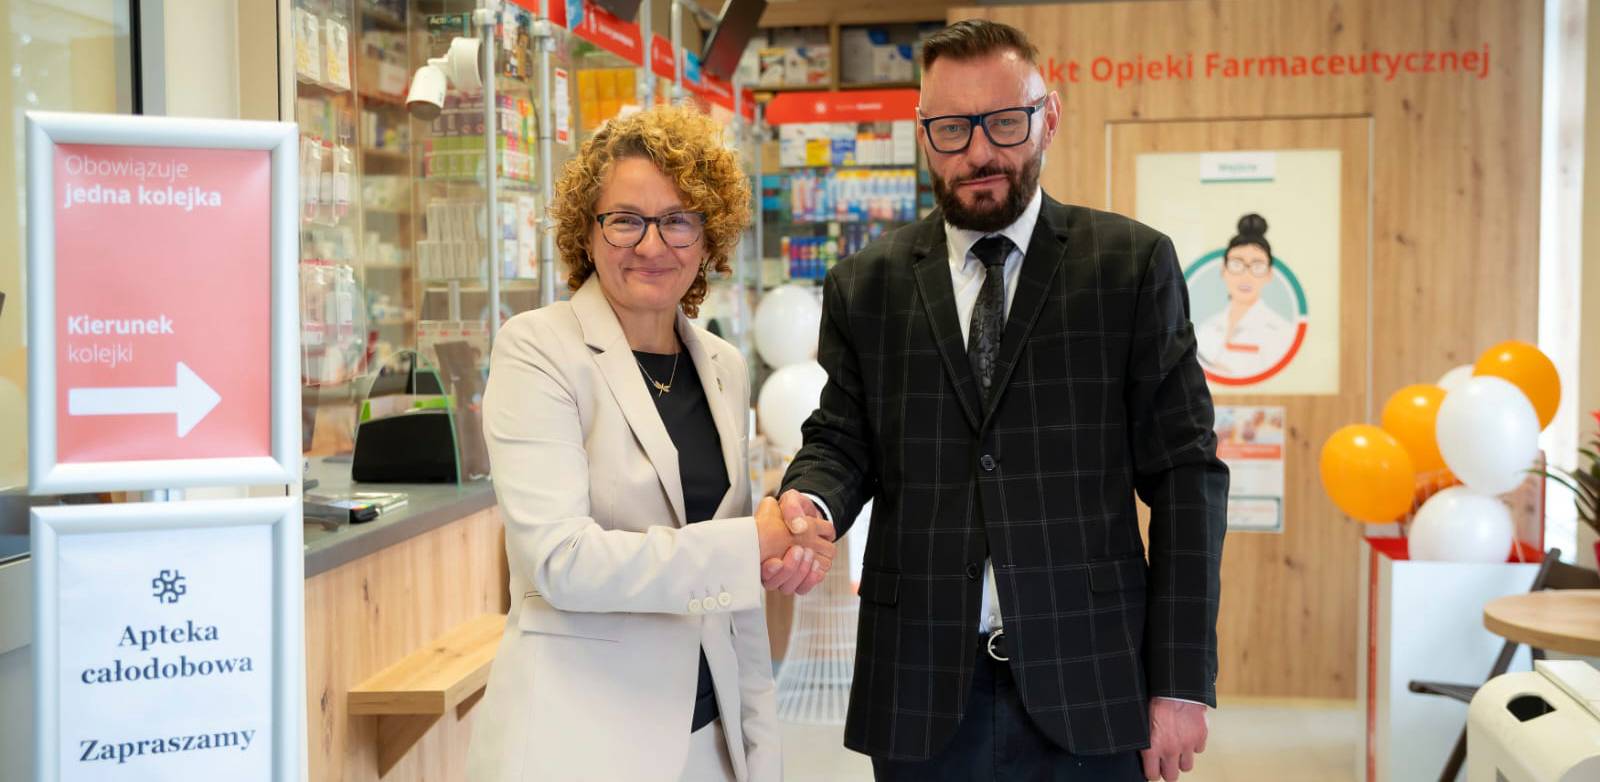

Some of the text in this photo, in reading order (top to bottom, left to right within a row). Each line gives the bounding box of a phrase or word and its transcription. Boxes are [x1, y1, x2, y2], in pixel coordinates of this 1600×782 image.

[1091, 52, 1194, 89] Opieki
[1204, 43, 1489, 82] Farmaceutycznej
[65, 154, 189, 183] Obowiązuje
[64, 183, 222, 212] jedna kolejka
[67, 314, 174, 336] Kierunek
[67, 343, 134, 369] kolejki
[118, 620, 220, 651] Apteka
[81, 655, 254, 685] całodobowa
[79, 729, 256, 763] Zapraszamy
